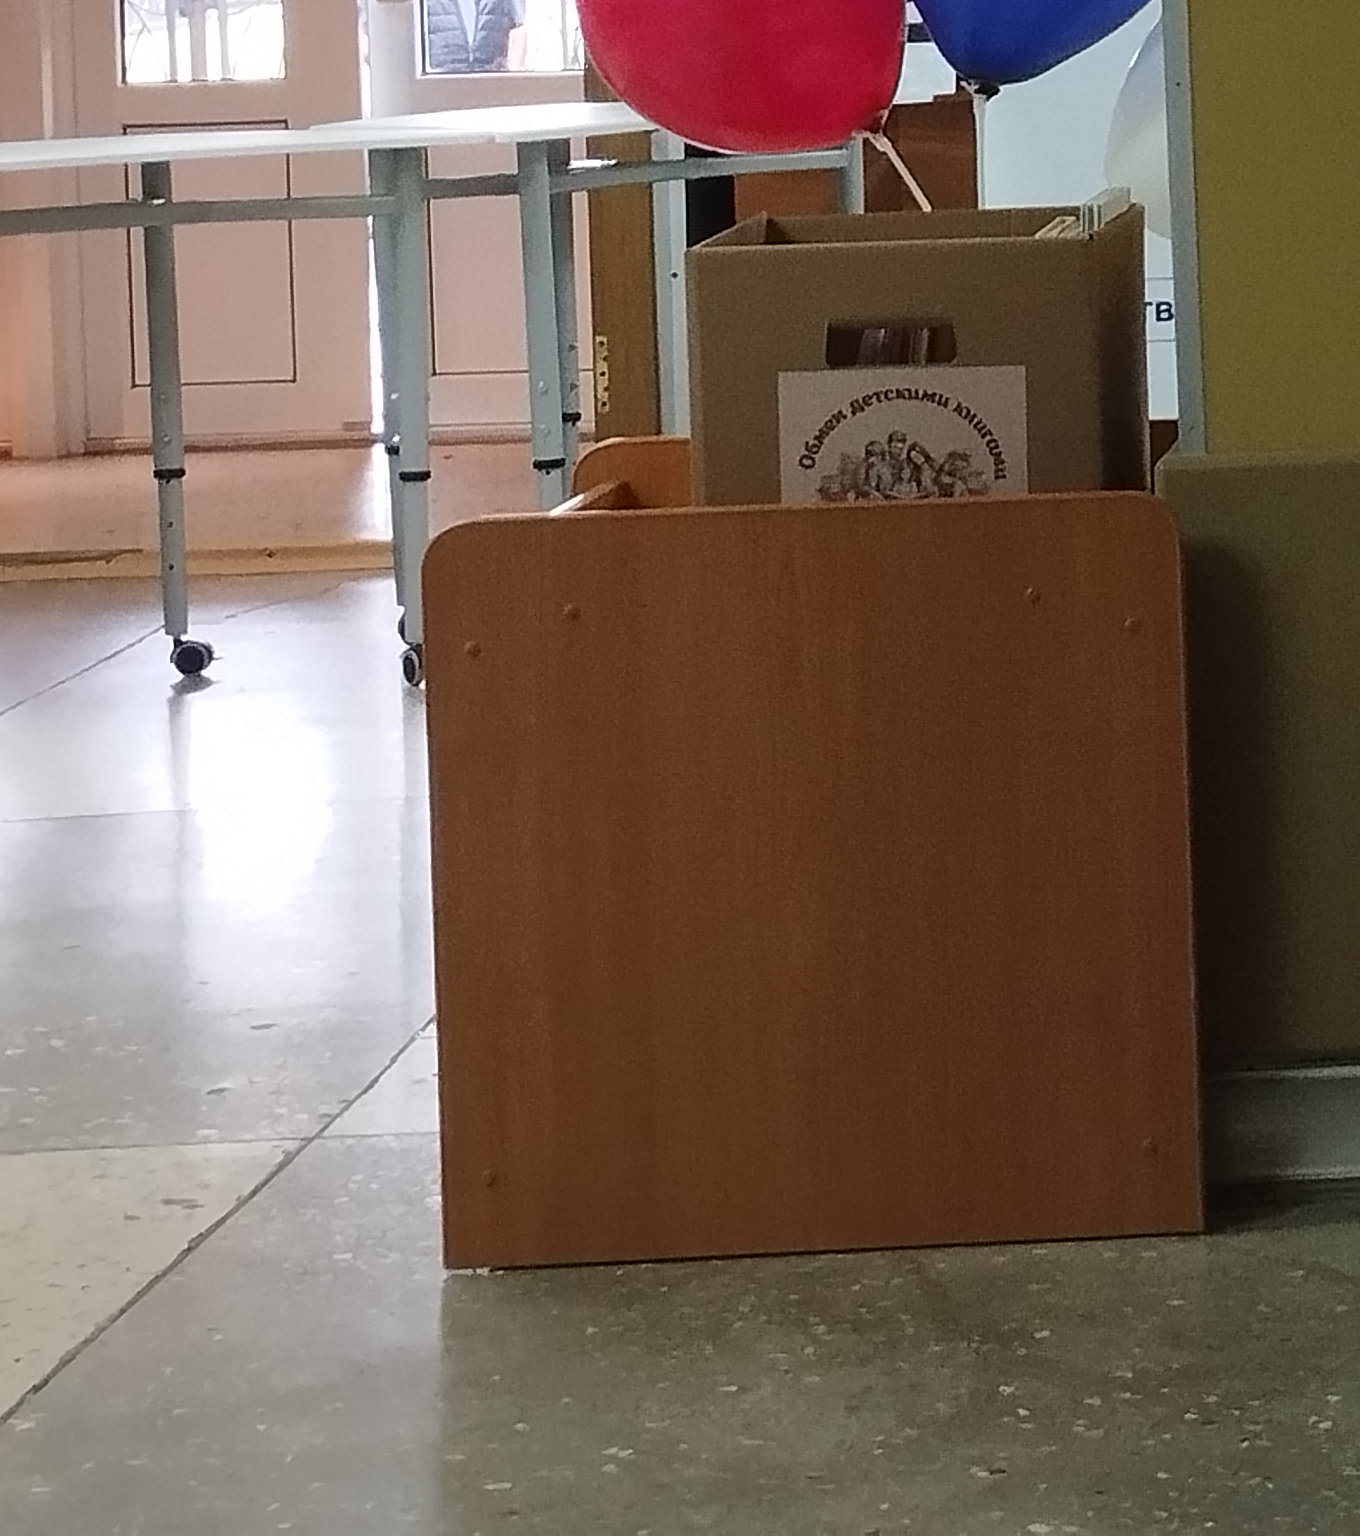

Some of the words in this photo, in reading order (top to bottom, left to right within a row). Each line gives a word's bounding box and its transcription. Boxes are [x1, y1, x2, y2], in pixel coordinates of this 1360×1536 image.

[798, 409, 848, 470] Обмен
[849, 387, 951, 417] детскими
[952, 398, 1008, 481] книгами
